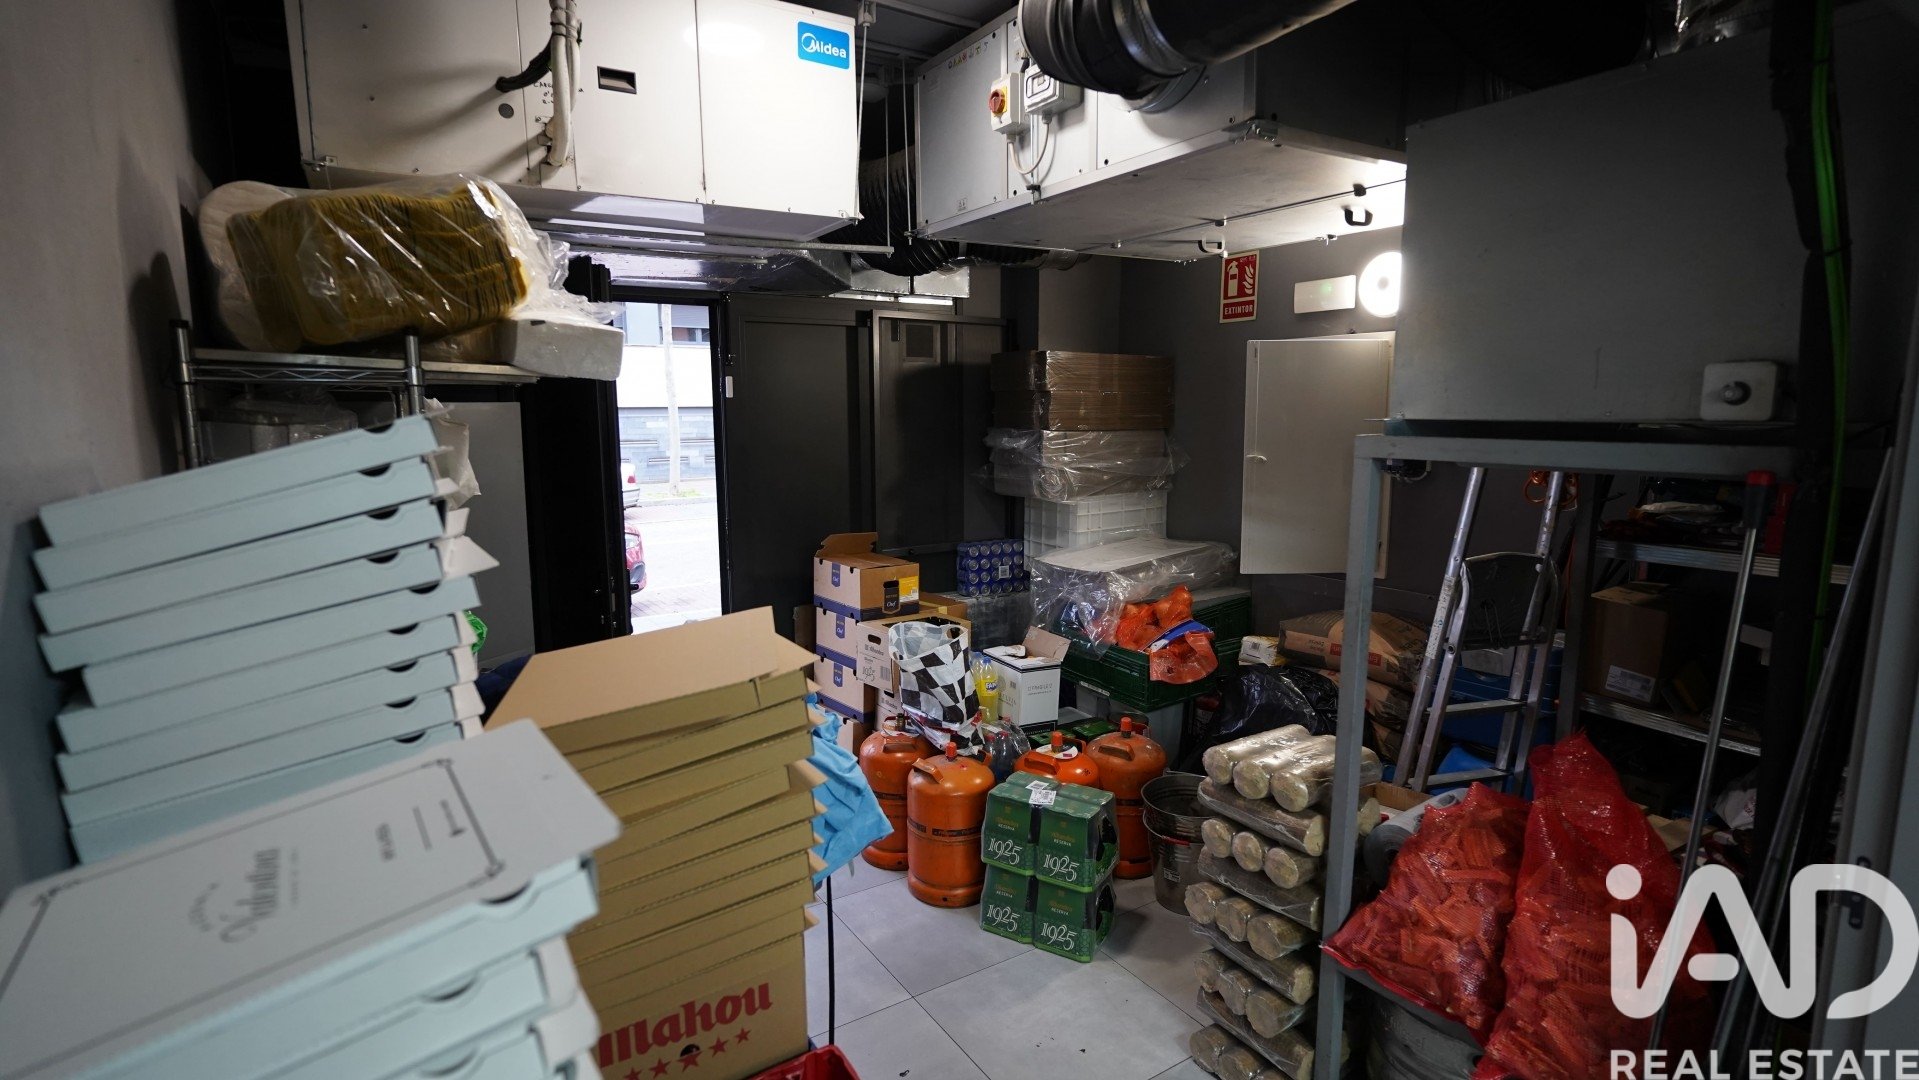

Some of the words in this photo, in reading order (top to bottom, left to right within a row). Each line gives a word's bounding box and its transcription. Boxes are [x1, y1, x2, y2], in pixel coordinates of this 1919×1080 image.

[801, 32, 847, 59] Midea
[1224, 305, 1253, 315] EXTINTOR
[988, 838, 1023, 865] 1925
[1043, 854, 1080, 882] 1925
[986, 904, 1021, 932] 1925
[1040, 922, 1078, 951] 1925
